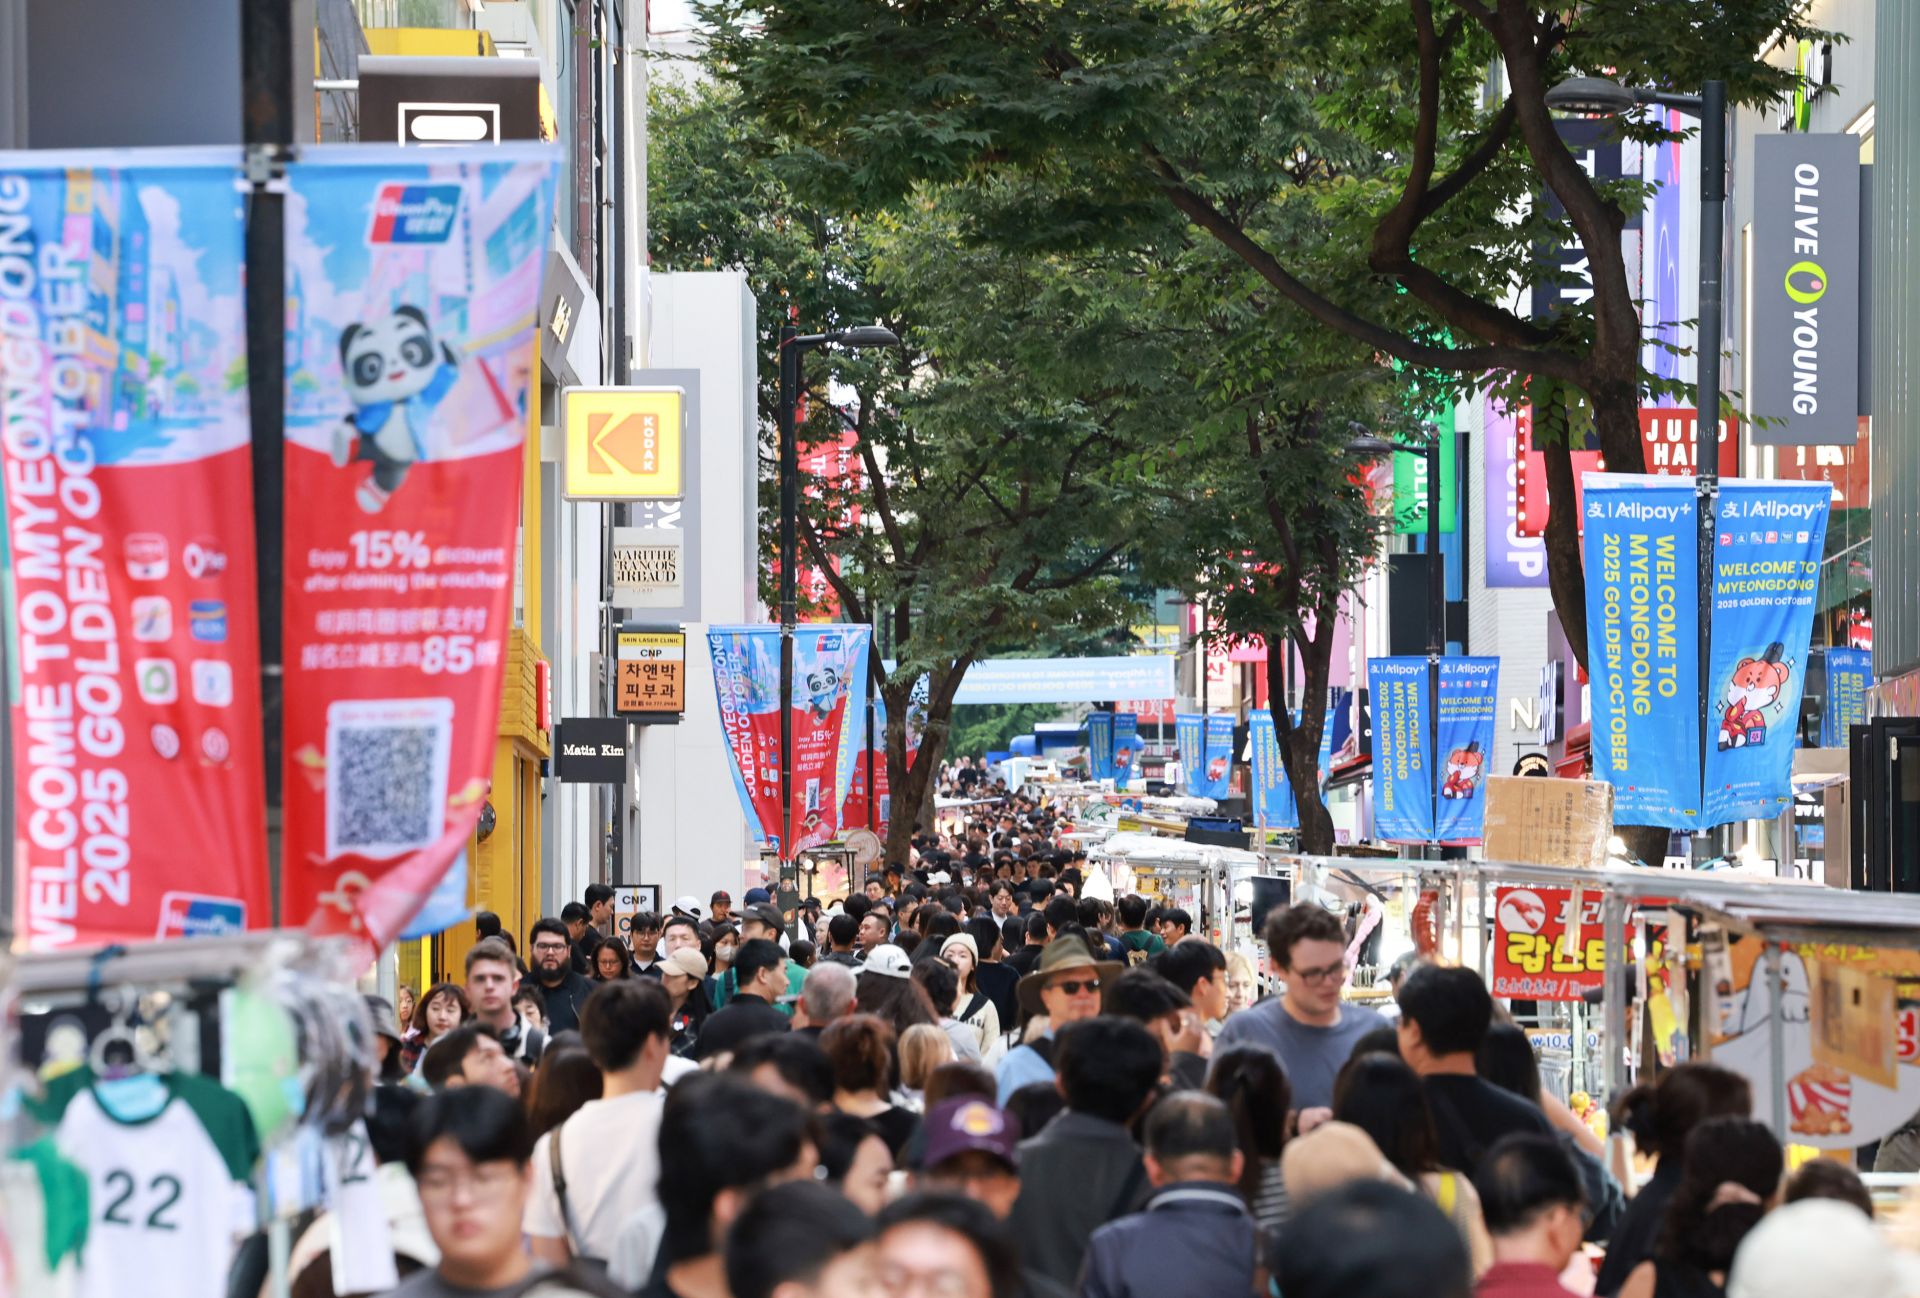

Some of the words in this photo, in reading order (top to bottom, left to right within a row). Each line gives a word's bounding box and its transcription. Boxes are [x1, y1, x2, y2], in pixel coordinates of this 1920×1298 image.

[1794, 163, 1819, 255] OLIVE
[38, 241, 101, 519] OCTOBER
[1793, 307, 1818, 415] YOUNG
[643, 415, 655, 471] KODAK
[1646, 419, 1727, 442] JUO
[1614, 501, 1692, 522] Alipay+
[1750, 499, 1826, 520] Alipay+
[349, 531, 431, 569] 15%
[1603, 533, 1621, 583] 2025
[1719, 560, 1796, 577] WELCOME
[1799, 561, 1817, 574] TO
[1656, 534, 1676, 657] WELCOME
[1717, 579, 1815, 594] MYEONGDONG
[1717, 599, 1738, 609] 2025
[1739, 597, 1773, 608] GOLDEN
[1774, 596, 1812, 606] OCTOBER
[20, 591, 70, 674] TO
[63, 526, 126, 757] GOLDEN
[1604, 589, 1622, 669] GOLDEN
[1629, 534, 1651, 716] MYEONGDONG
[626, 662, 676, 681] 차앤박
[640, 649, 662, 658] CNP
[626, 683, 675, 699] 피부과
[727, 652, 750, 729] OCTOBER
[1379, 681, 1390, 709] 2025
[1440, 697, 1481, 705] WELCOME
[1483, 696, 1494, 704] TO
[1658, 666, 1677, 698] TO
[1381, 711, 1393, 756] GOLDEN
[1393, 681, 1408, 780] MYEONGDONG
[1407, 681, 1420, 748] WELCOME
[1440, 706, 1493, 715] MYEONGDONG
[1608, 673, 1628, 771] OCTOBER
[563, 744, 597, 756] Matin
[601, 744, 624, 756] Kim
[1411, 752, 1421, 770] TO
[1382, 758, 1394, 811] OCTOBER
[25, 683, 79, 952] WELCOME
[81, 768, 131, 906] 2025
[622, 895, 647, 905] CNP
[104, 1169, 184, 1230] 22
